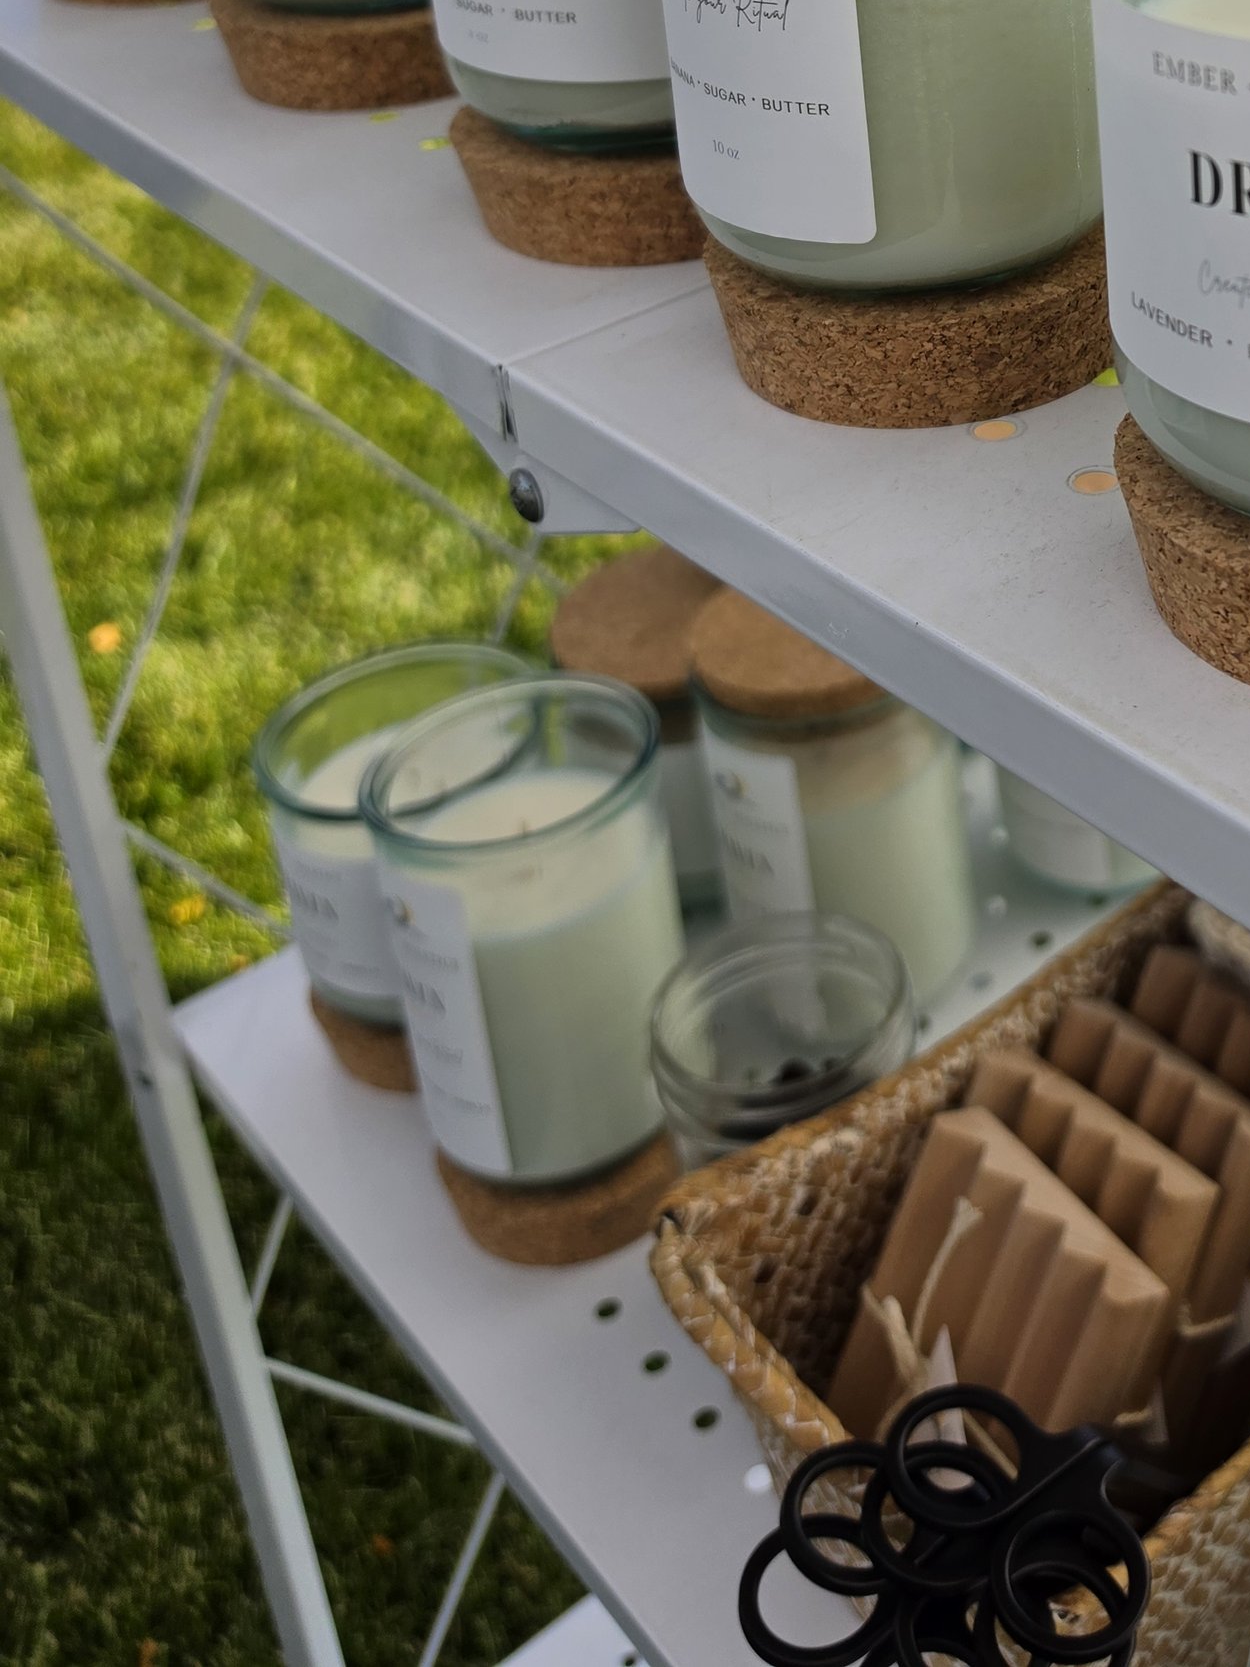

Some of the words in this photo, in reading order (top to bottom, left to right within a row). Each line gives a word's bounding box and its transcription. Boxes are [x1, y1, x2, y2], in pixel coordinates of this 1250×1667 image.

[514, 7, 578, 24] BUTTER
[1152, 50, 1238, 96] EMBER
[703, 82, 748, 107] SUGAR
[761, 97, 831, 117] BUTTER
[712, 138, 725, 155] 10
[1131, 290, 1214, 348] LAVENDER
